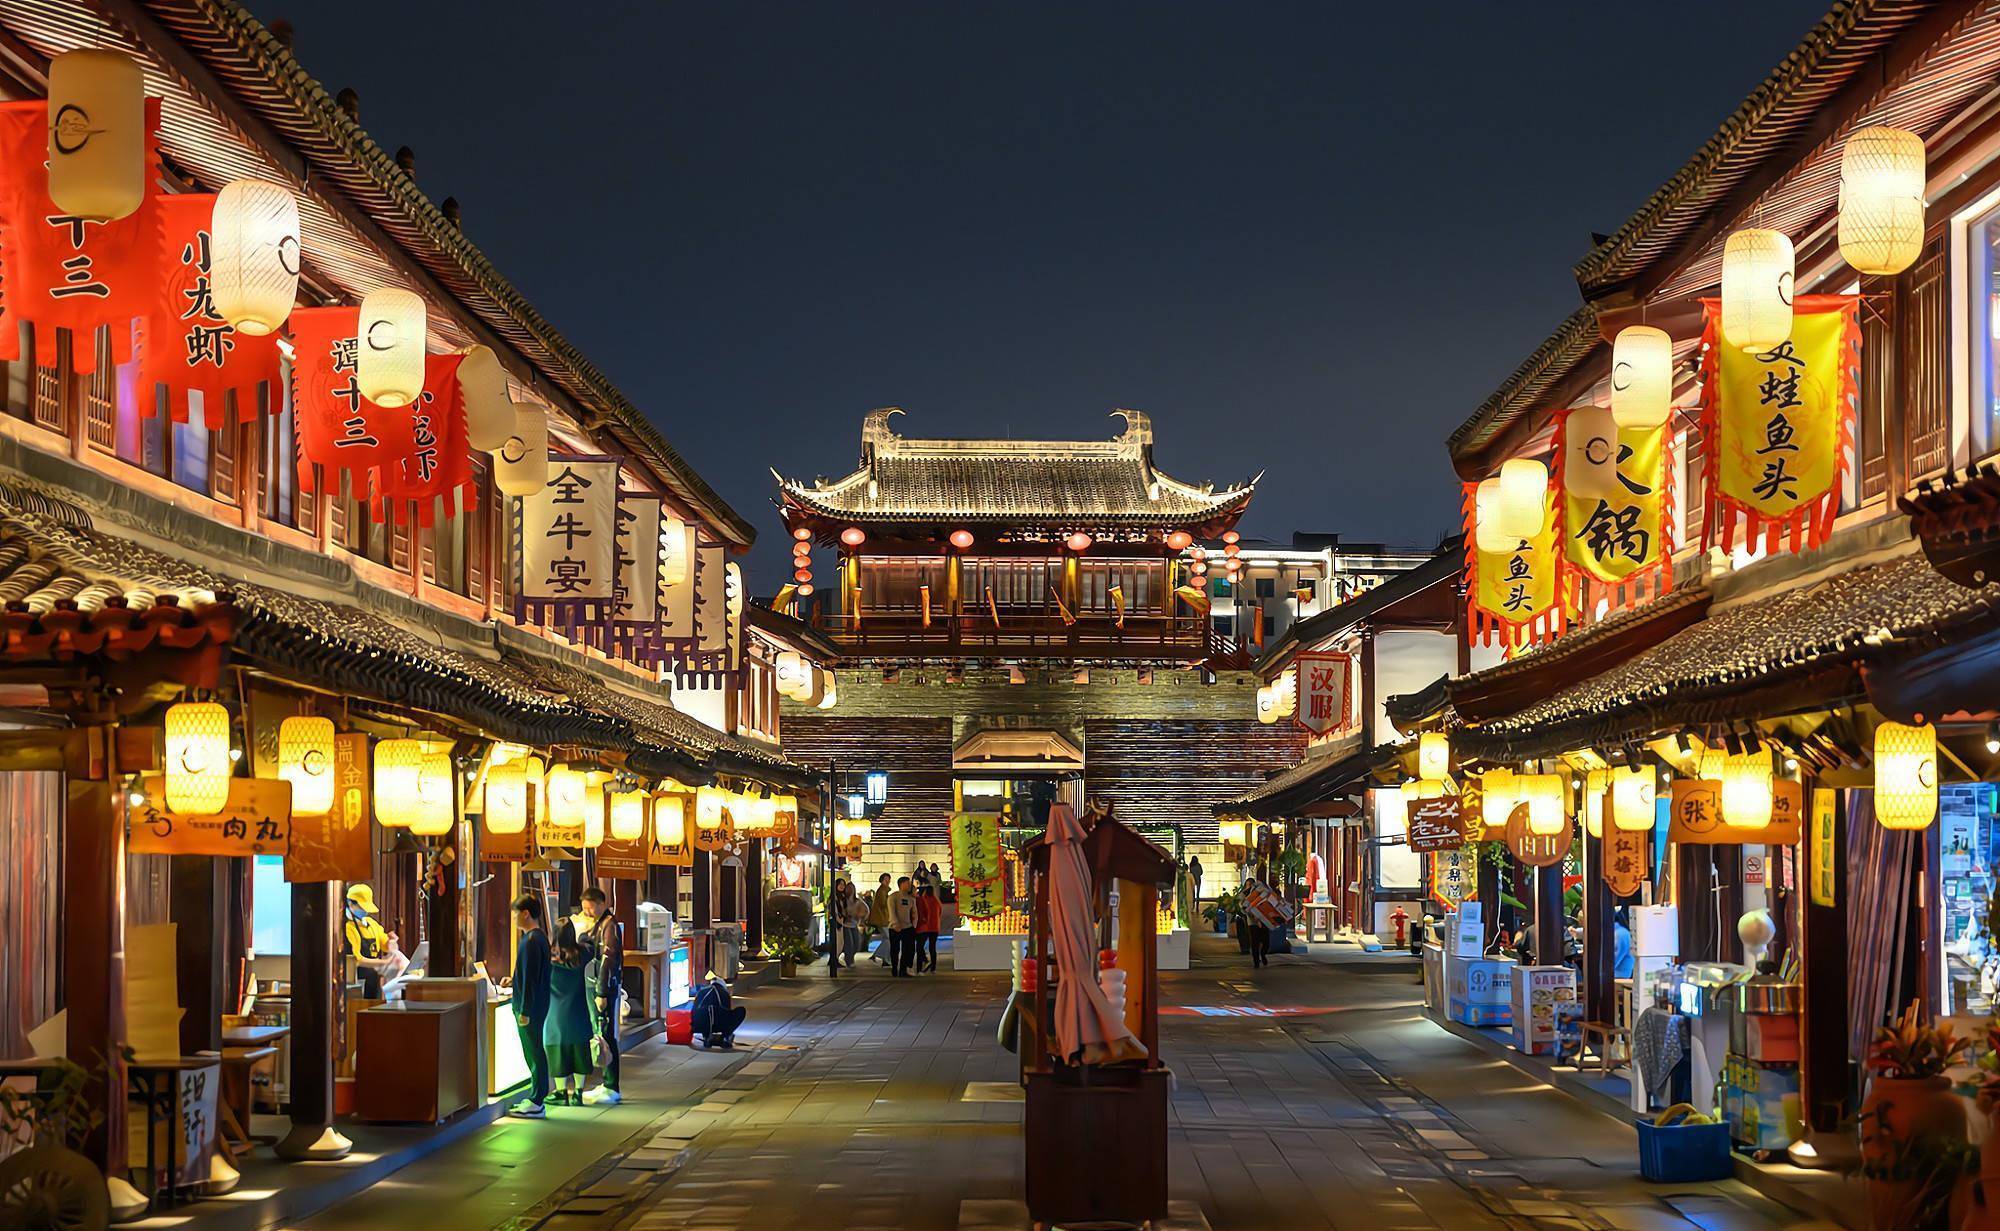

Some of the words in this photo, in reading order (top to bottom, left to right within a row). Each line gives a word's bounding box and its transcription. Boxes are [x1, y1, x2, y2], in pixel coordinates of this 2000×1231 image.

[181, 230, 235, 367] 小龙虾
[545, 466, 593, 594] 全牛宴
[1502, 539, 1534, 612] 鱼头
[1309, 666, 1335, 721] 汉服
[223, 815, 284, 841] 肉丸
[965, 820, 987, 881] 棉花糖
